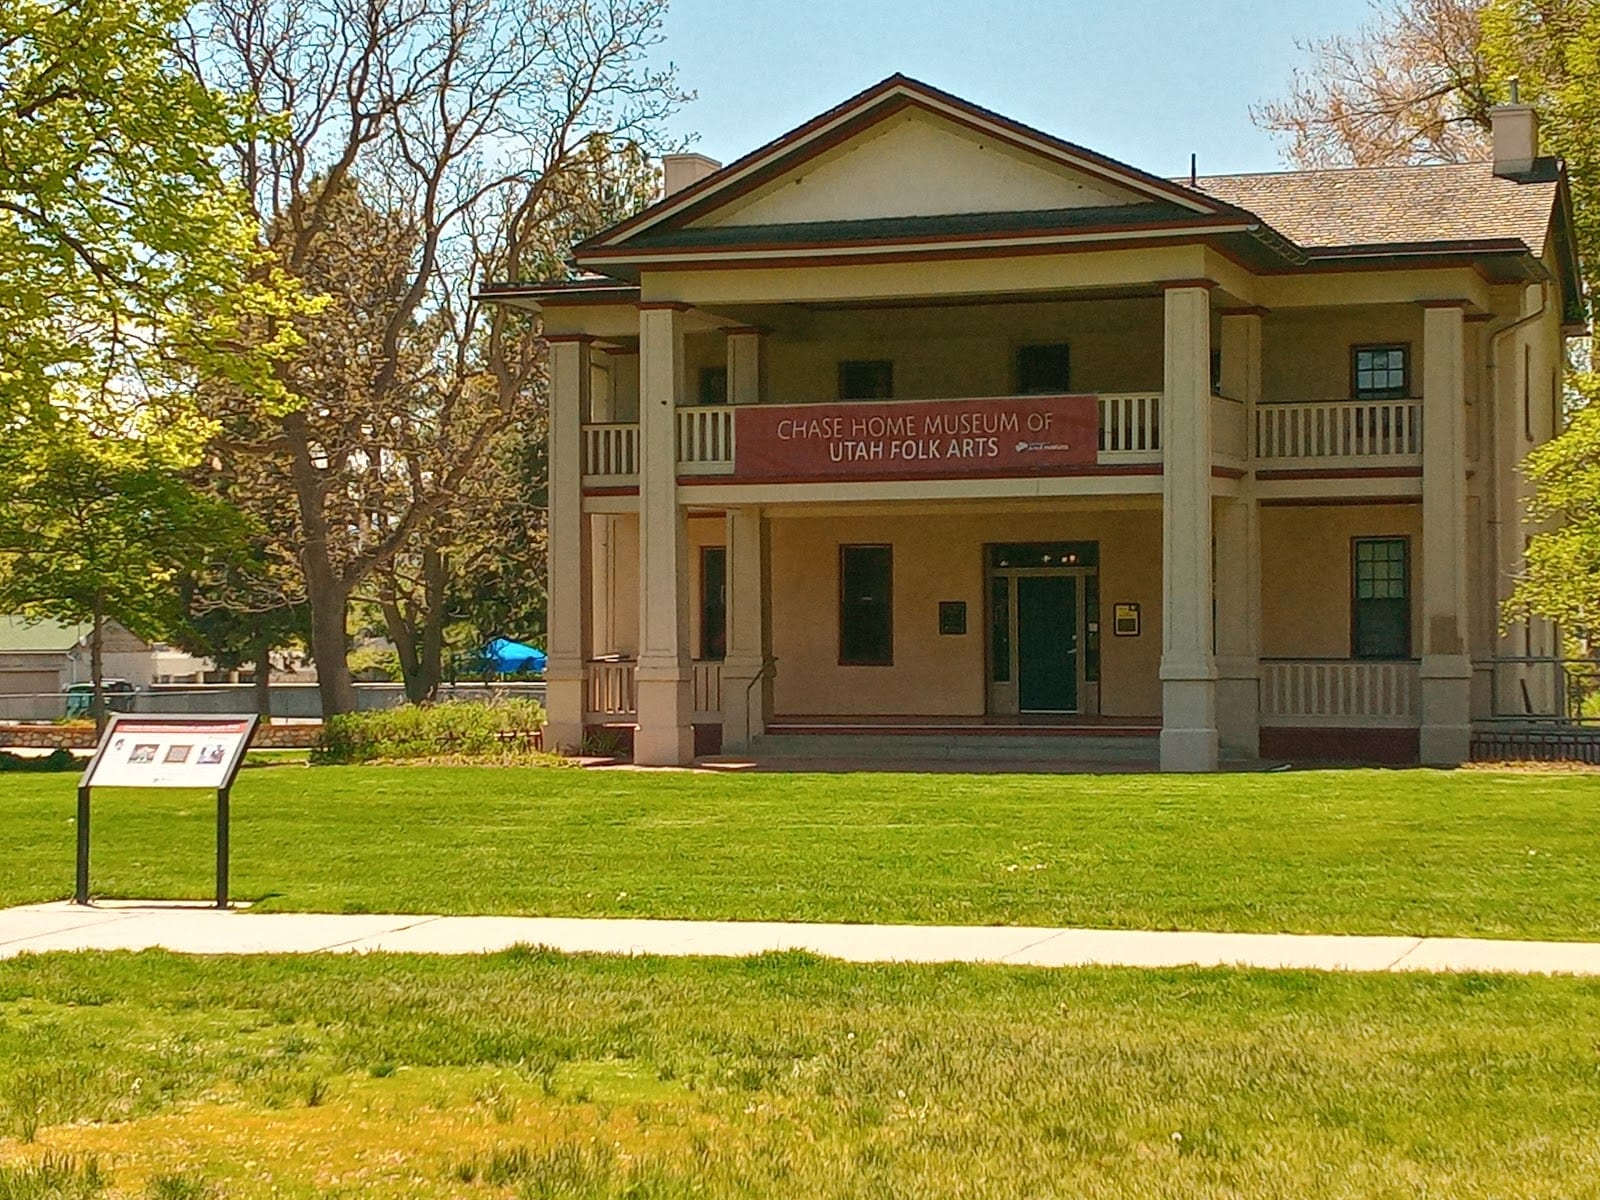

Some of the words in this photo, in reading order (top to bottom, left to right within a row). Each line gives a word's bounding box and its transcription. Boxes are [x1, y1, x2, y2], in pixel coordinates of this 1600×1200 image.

[777, 417, 843, 440] CHASE
[851, 415, 916, 437] HOME
[924, 412, 1020, 436] MUSEUM
[1027, 412, 1054, 432] OF
[830, 440, 883, 462] UTAH
[889, 438, 941, 460] FOLK
[946, 436, 999, 459] ARTS
